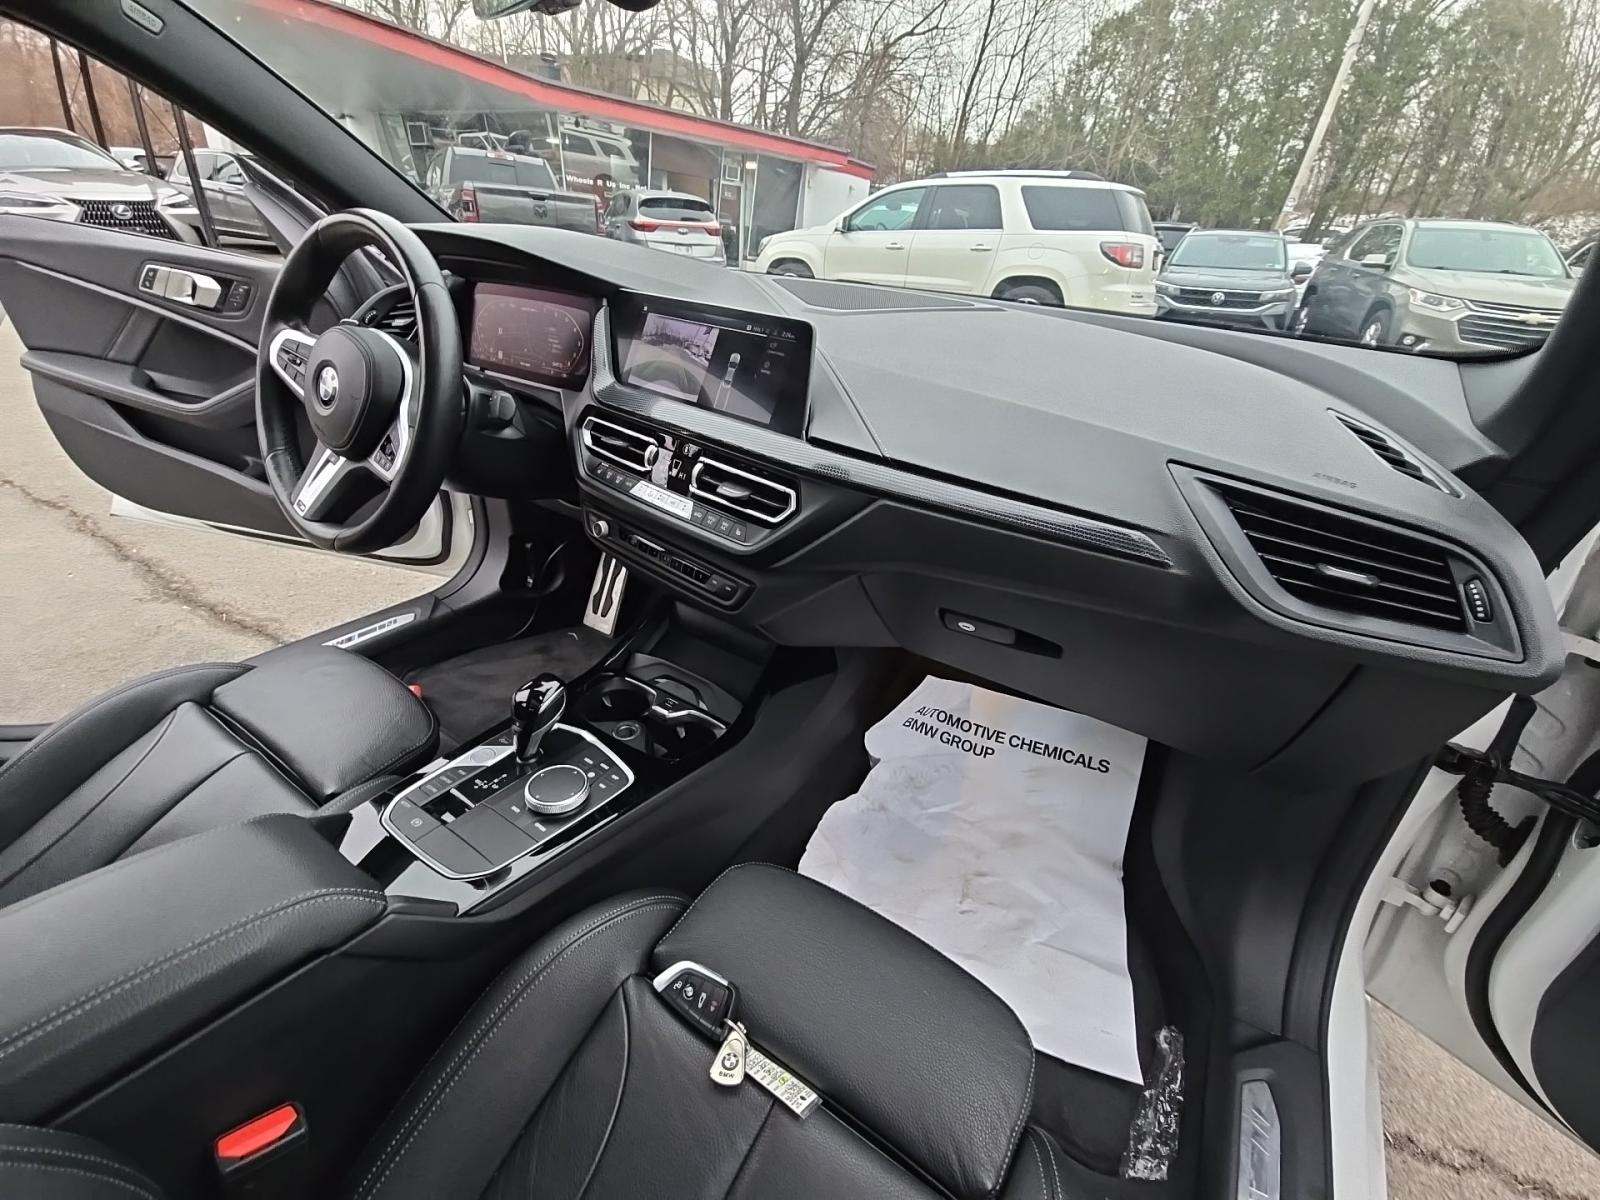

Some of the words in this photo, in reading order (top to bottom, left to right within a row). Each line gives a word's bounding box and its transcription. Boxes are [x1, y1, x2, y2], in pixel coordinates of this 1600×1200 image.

[902, 716, 939, 739] BMW
[939, 731, 996, 759] GROUP
[914, 704, 1006, 745] AUTOMOTIVE
[1008, 733, 1111, 774] CHEMICALS
